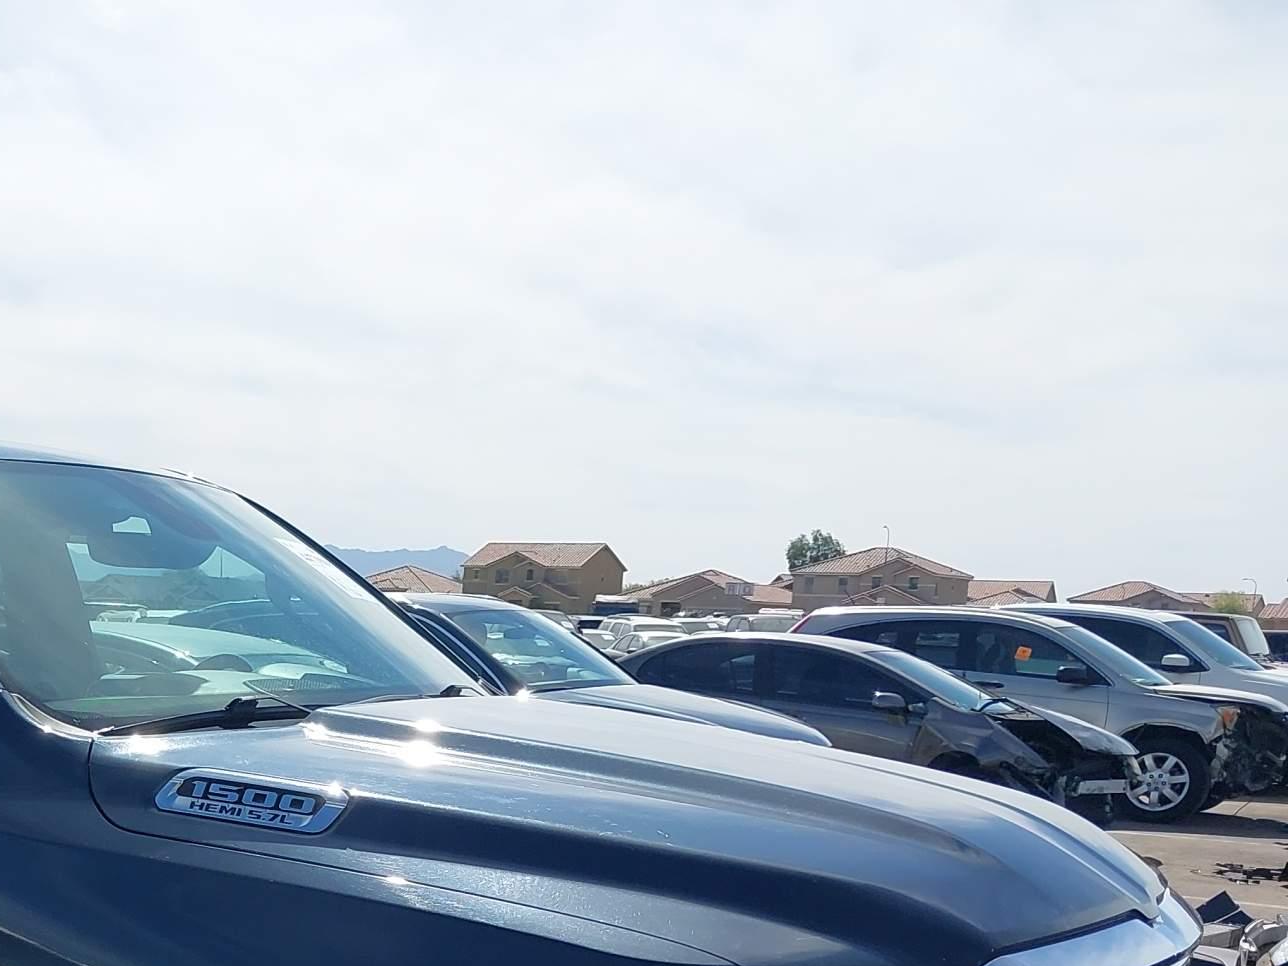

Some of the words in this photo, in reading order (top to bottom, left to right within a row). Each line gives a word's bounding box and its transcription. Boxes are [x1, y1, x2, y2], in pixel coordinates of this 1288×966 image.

[189, 799, 242, 818] HEMI
[248, 810, 293, 826] 5.7L
[191, 780, 316, 815] 1500
